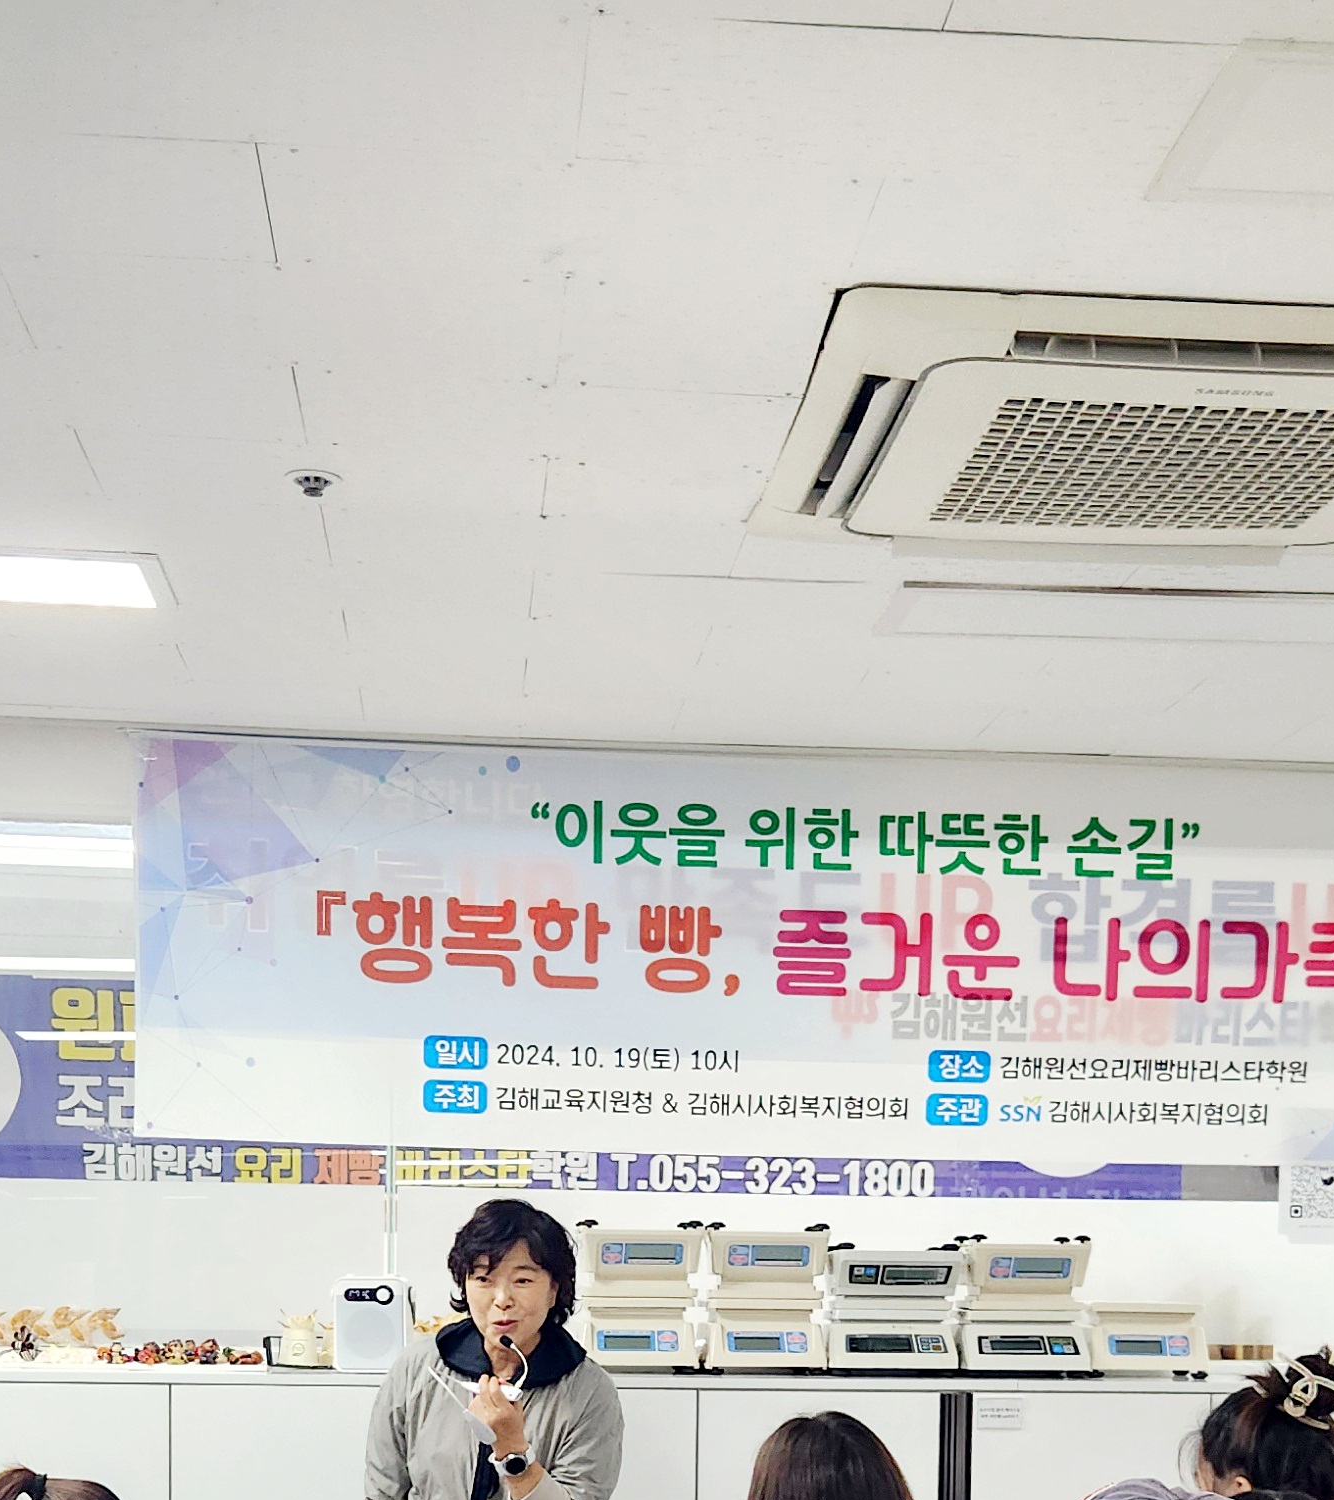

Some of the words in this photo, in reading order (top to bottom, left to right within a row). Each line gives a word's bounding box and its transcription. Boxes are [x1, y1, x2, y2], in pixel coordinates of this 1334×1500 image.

[1194, 387, 1275, 397] SAMSUNG
[531, 799, 725, 868] “이웃을
[745, 806, 859, 871] 위한
[878, 811, 1049, 876] 따뜻한
[1067, 816, 1200, 881] 손길”
[316, 889, 611, 990] 『행복한
[638, 904, 741, 997] 빵,
[772, 909, 1021, 1001] 즐거운
[434, 1038, 481, 1068] 일시
[496, 1044, 561, 1068] 2024.
[571, 1045, 604, 1069] 10.
[614, 1046, 681, 1072] 19(토)
[690, 1049, 741, 1073] 10시
[938, 1053, 984, 1080] 장소
[999, 1056, 1309, 1084] 김해원선요리제빵바리스타학원
[433, 1083, 480, 1110] 주최
[496, 1086, 652, 1114] 김해교육지원청
[662, 1092, 679, 1114] &
[687, 1092, 909, 1121] 김해시사회복지협의회
[935, 1096, 981, 1123] 주관
[999, 1103, 1042, 1123] SSN
[1048, 1100, 1268, 1126] 김해시사회복지협의회
[81, 1140, 223, 1183] 김해원선
[234, 1146, 302, 1185] 요리
[312, 1147, 385, 1187] 제빵
[609, 1151, 936, 1198] T.055-323-1800
